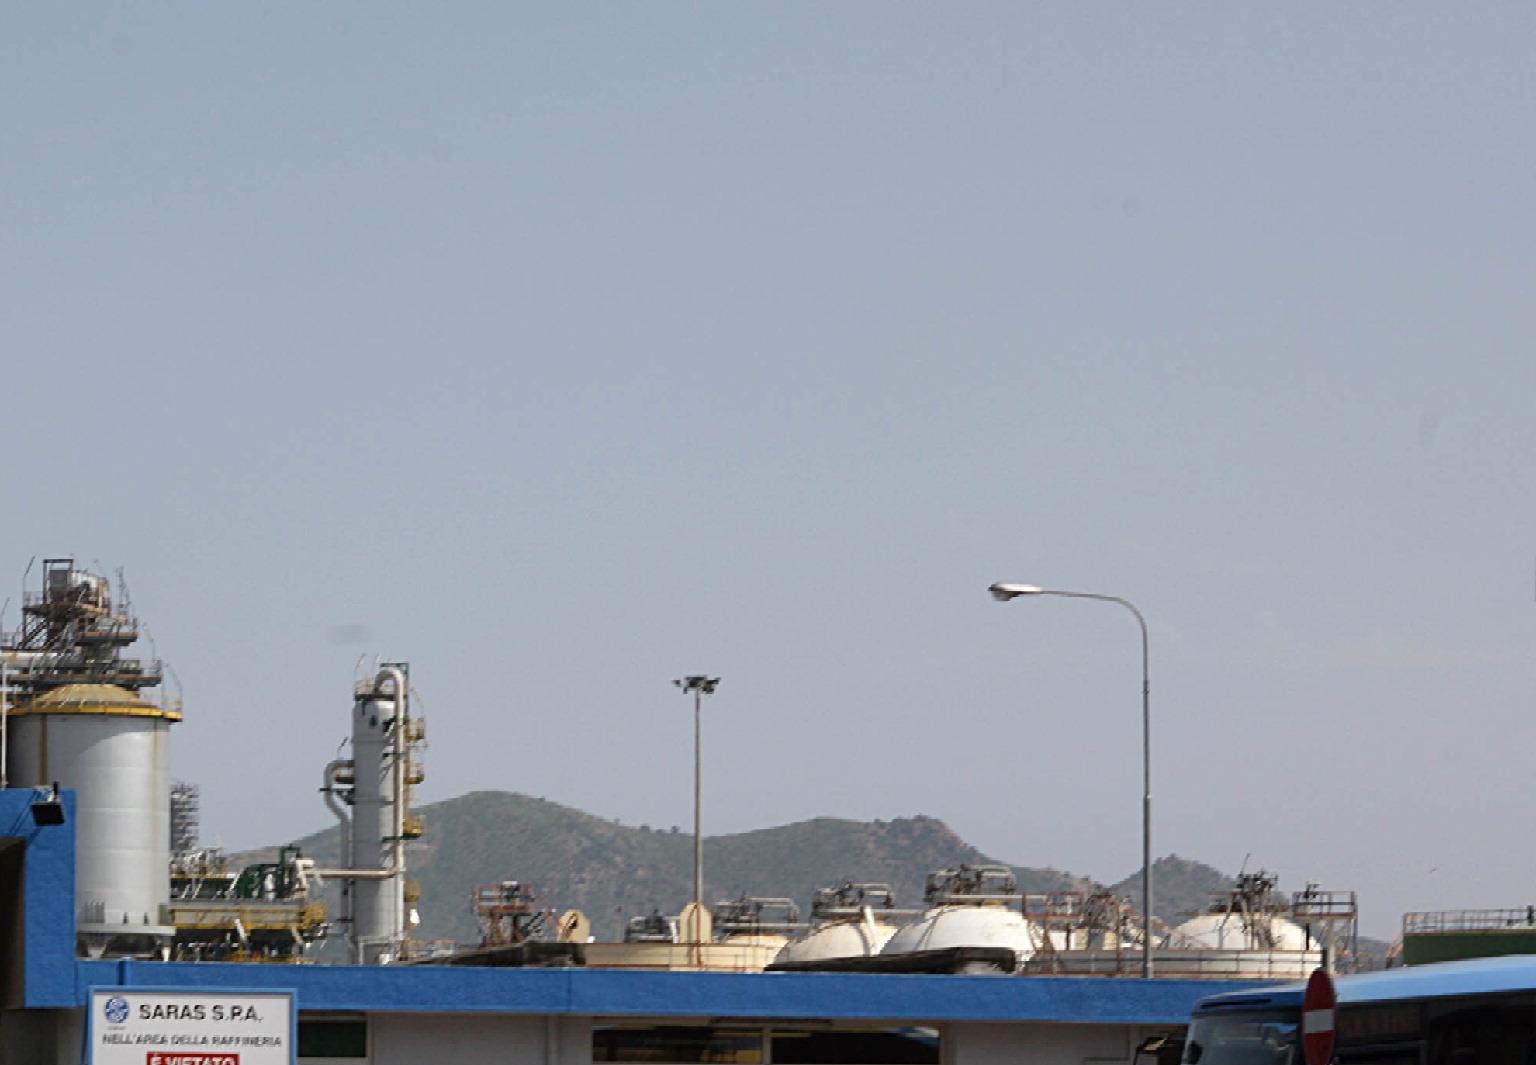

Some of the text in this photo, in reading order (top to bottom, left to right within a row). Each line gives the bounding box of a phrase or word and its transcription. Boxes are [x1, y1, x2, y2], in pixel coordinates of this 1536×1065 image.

[138, 1004, 264, 1022] SARAS S.P.A.
[102, 1034, 282, 1047] NELL'AREA DELLA RAFFINERIA
